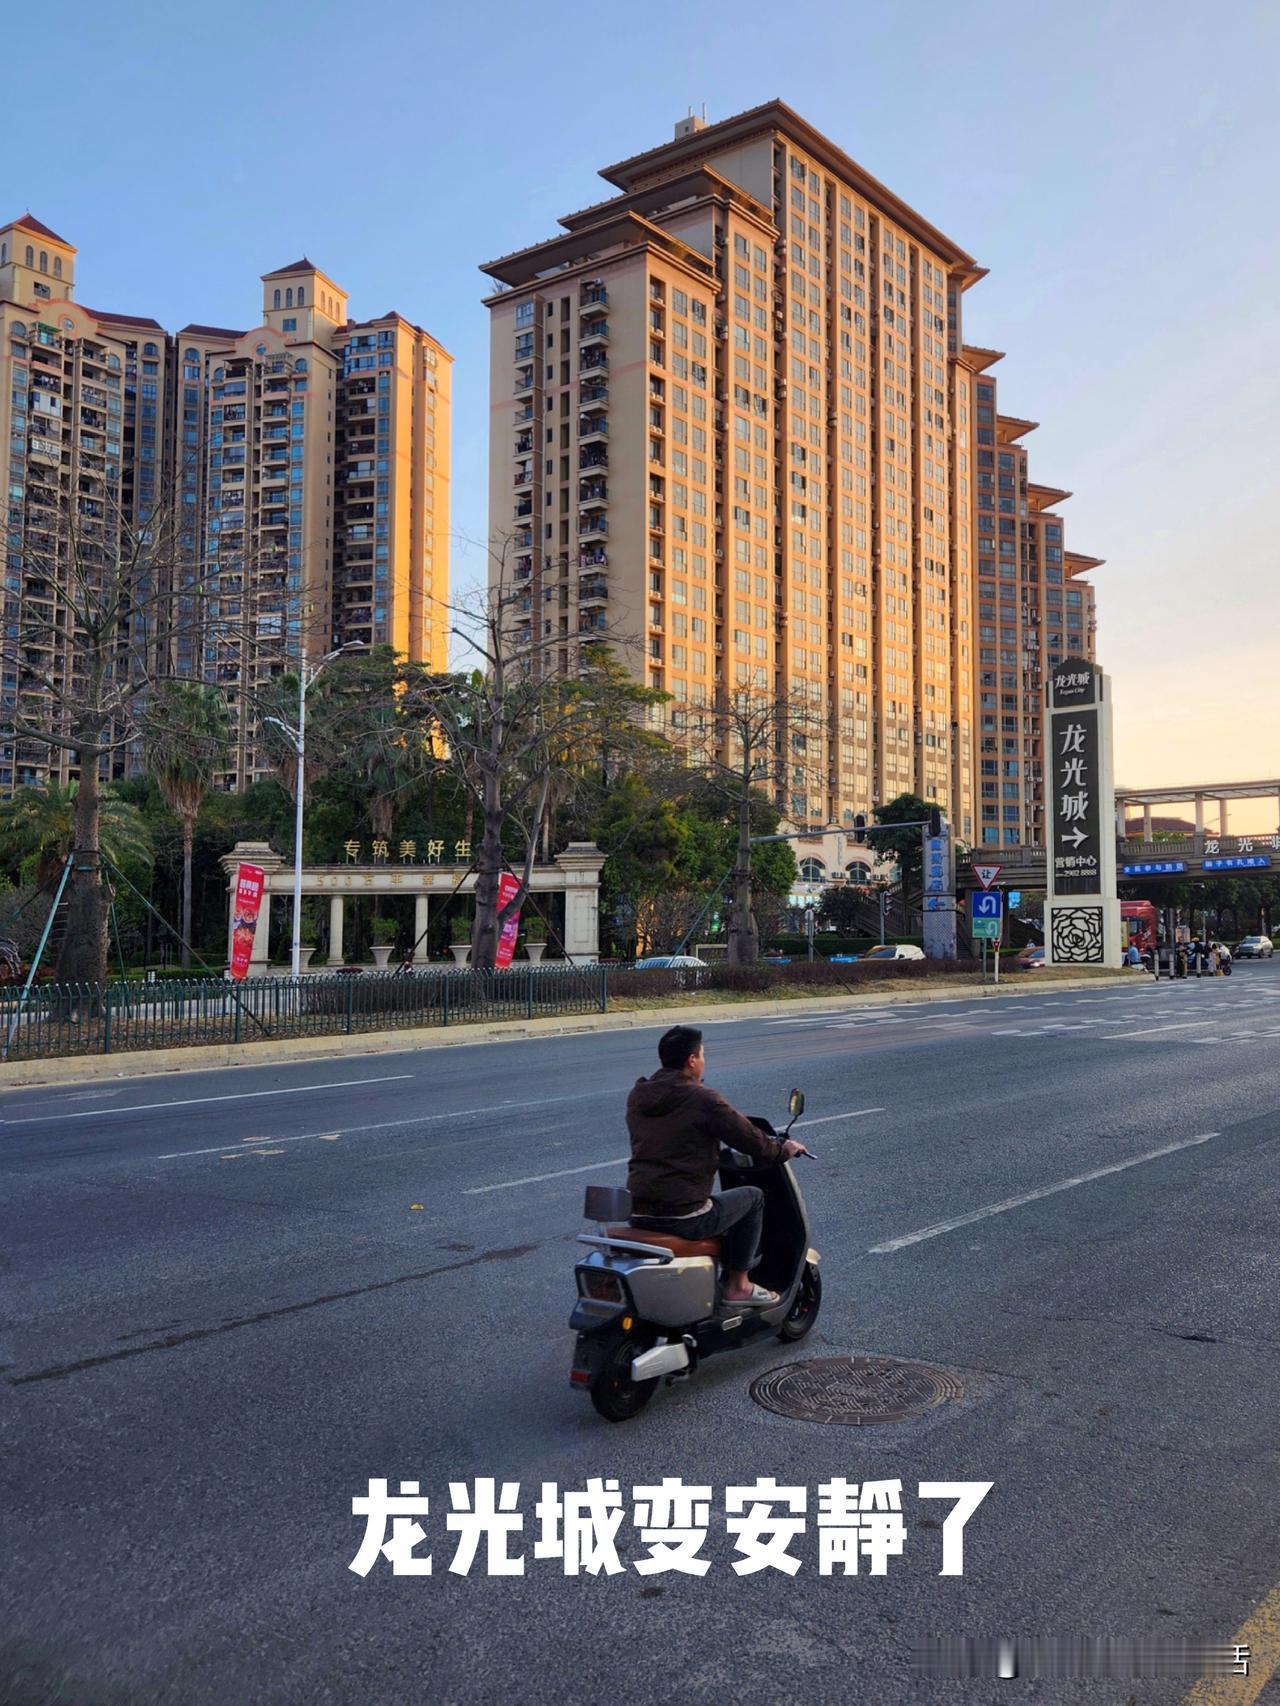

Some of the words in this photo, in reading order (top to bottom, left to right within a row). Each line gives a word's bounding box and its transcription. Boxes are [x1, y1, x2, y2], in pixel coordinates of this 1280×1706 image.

[1054, 671, 1090, 689] 龙光城
[1059, 723, 1088, 822] 龙光城
[1055, 855, 1097, 868] 营销中心
[981, 868, 992, 879] 让
